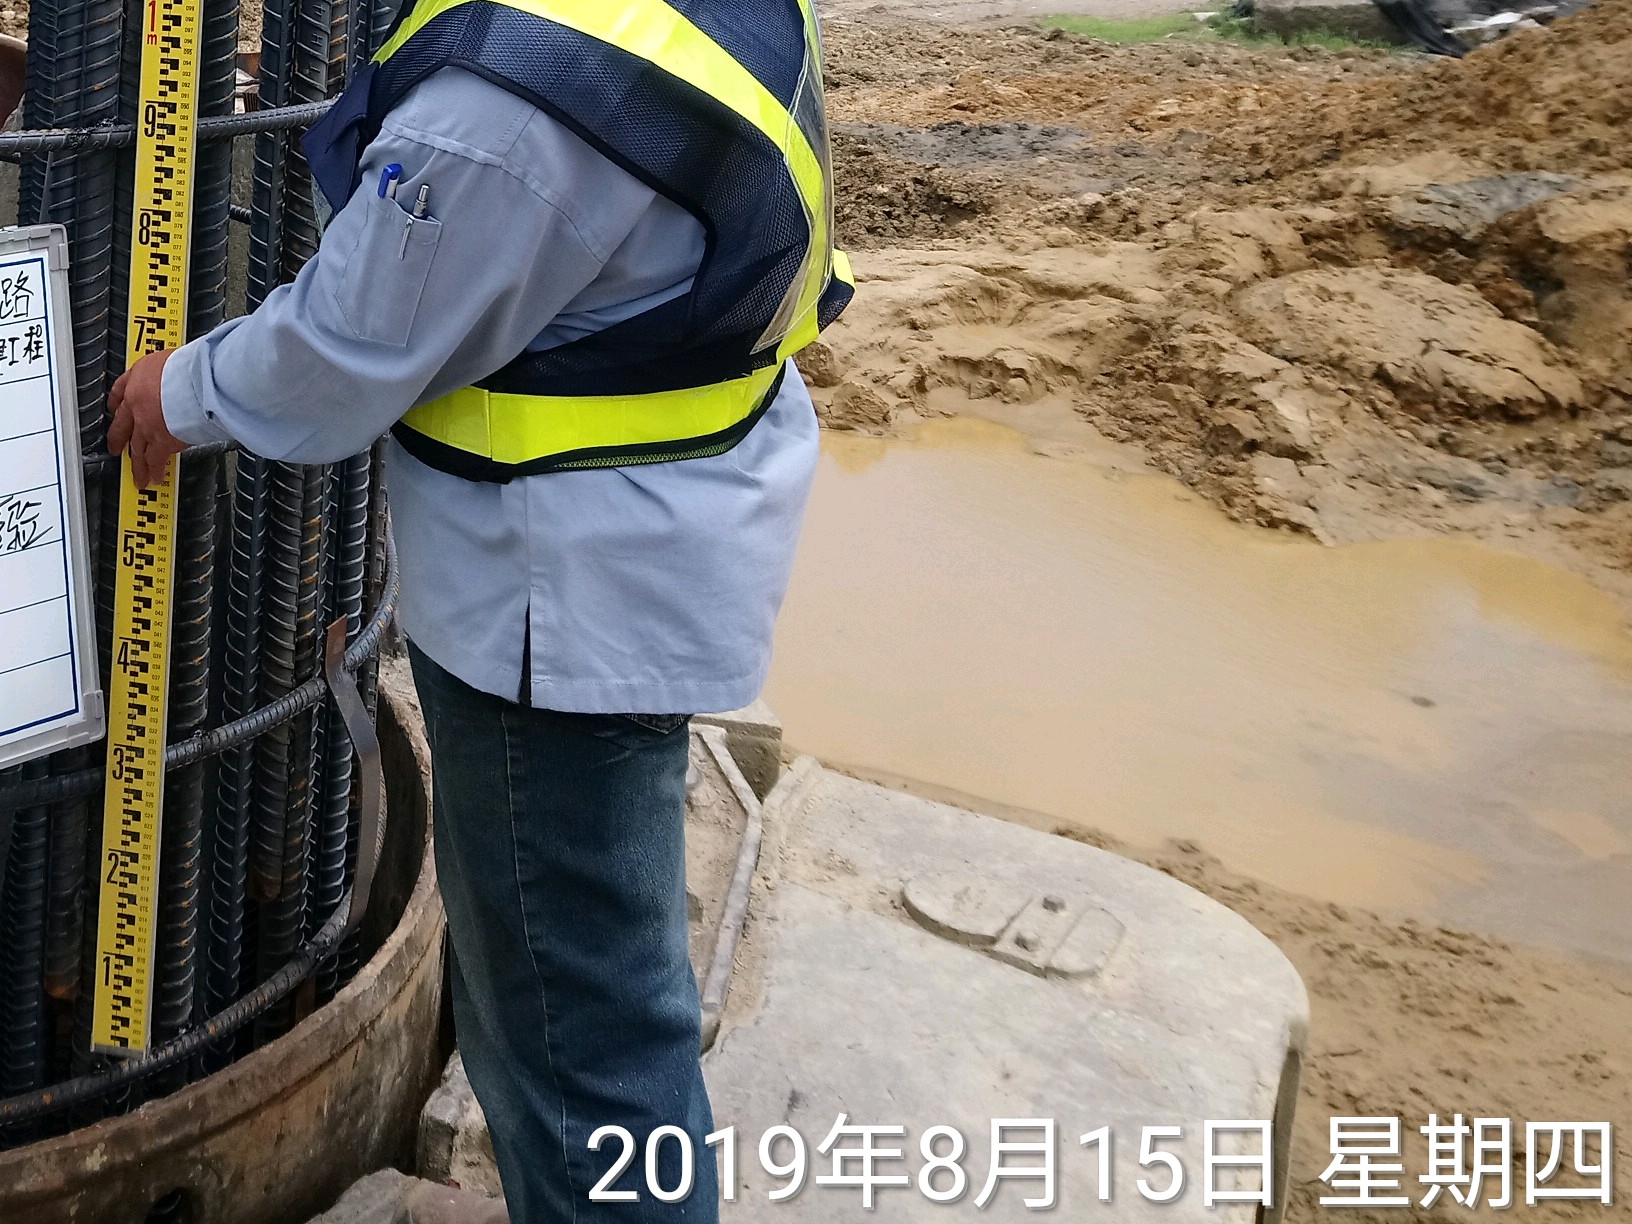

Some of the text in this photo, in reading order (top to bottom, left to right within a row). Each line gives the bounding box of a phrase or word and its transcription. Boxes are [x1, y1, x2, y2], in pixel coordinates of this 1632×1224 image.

[148, 0, 156, 32] 1
[144, 103, 156, 138] 9
[139, 211, 150, 246] 8
[133, 320, 145, 353] 7
[123, 534, 135, 567] 5
[117, 642, 130, 674] 4
[112, 748, 124, 781] 3
[107, 853, 119, 885] 2
[102, 955, 111, 987] 1
